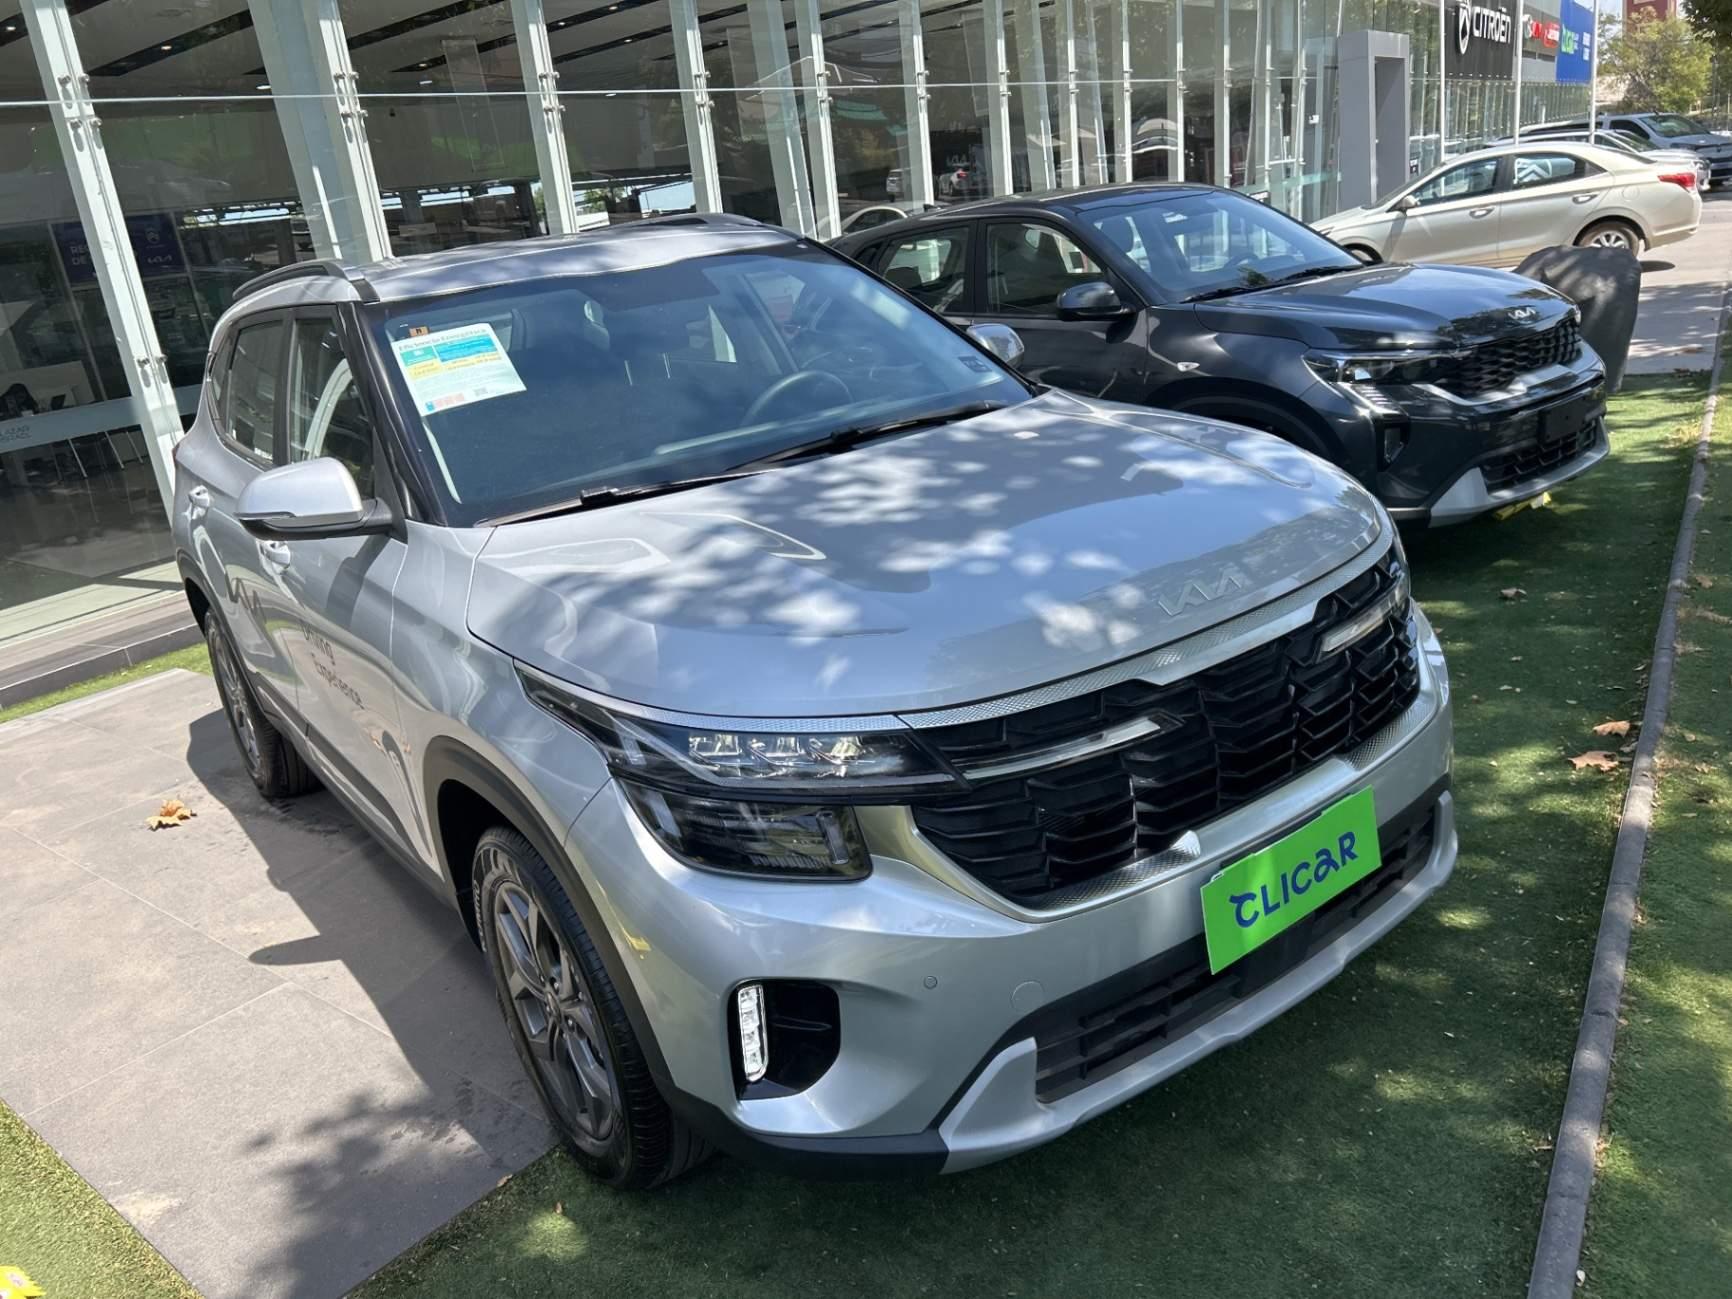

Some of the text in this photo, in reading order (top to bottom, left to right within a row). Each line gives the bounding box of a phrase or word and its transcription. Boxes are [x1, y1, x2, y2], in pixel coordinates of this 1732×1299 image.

[1472, 6, 1511, 44] CITROËN
[1507, 307, 1536, 320] KIA
[1158, 567, 1244, 616] KIA
